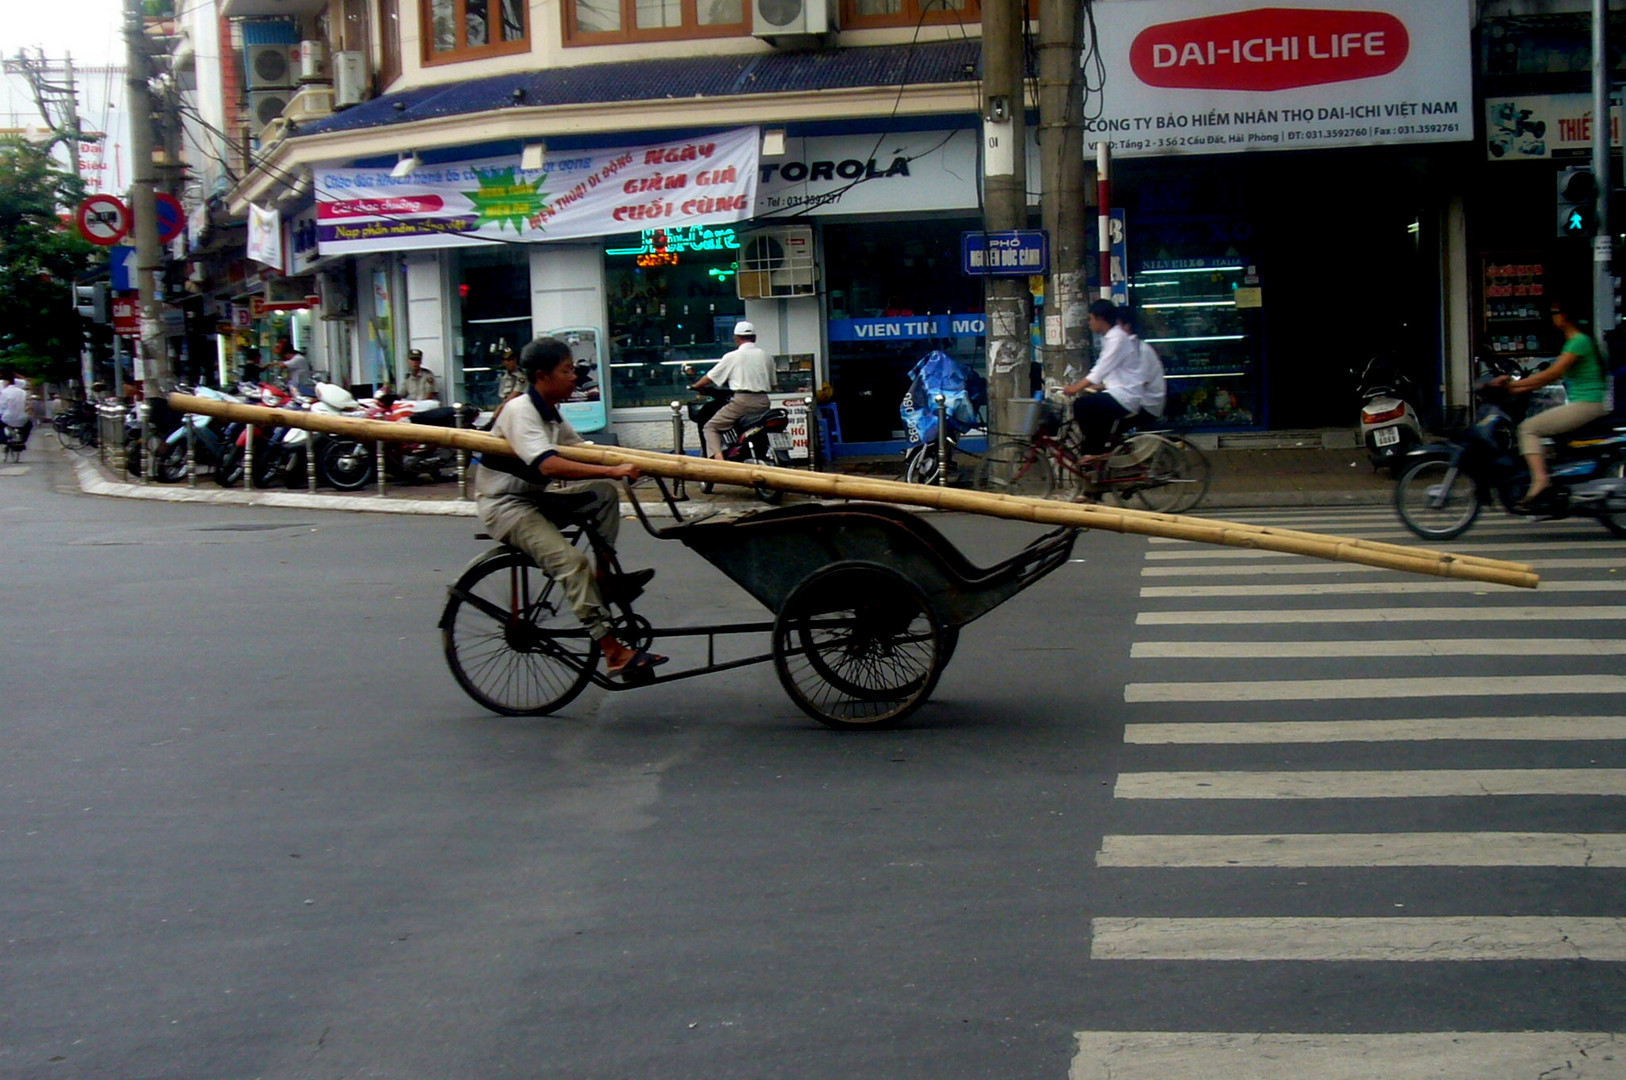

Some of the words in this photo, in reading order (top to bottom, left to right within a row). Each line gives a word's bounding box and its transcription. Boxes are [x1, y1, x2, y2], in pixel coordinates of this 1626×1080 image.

[1153, 36, 1299, 68] DAI-ICHI
[1308, 31, 1385, 59] LIFE
[1134, 117, 1152, 130] TY
[1282, 108, 1314, 124] THỌ
[1318, 104, 1380, 121] DAI-ICHI
[1384, 101, 1418, 119] VIỆT
[1421, 101, 1458, 115] NAM
[1558, 110, 1593, 142] THIẾ
[644, 143, 716, 165] NGÀY
[623, 171, 687, 194] GIẢM
[696, 165, 737, 186] GIÁ
[904, 321, 937, 335] TIN
[952, 319, 985, 333] MO
